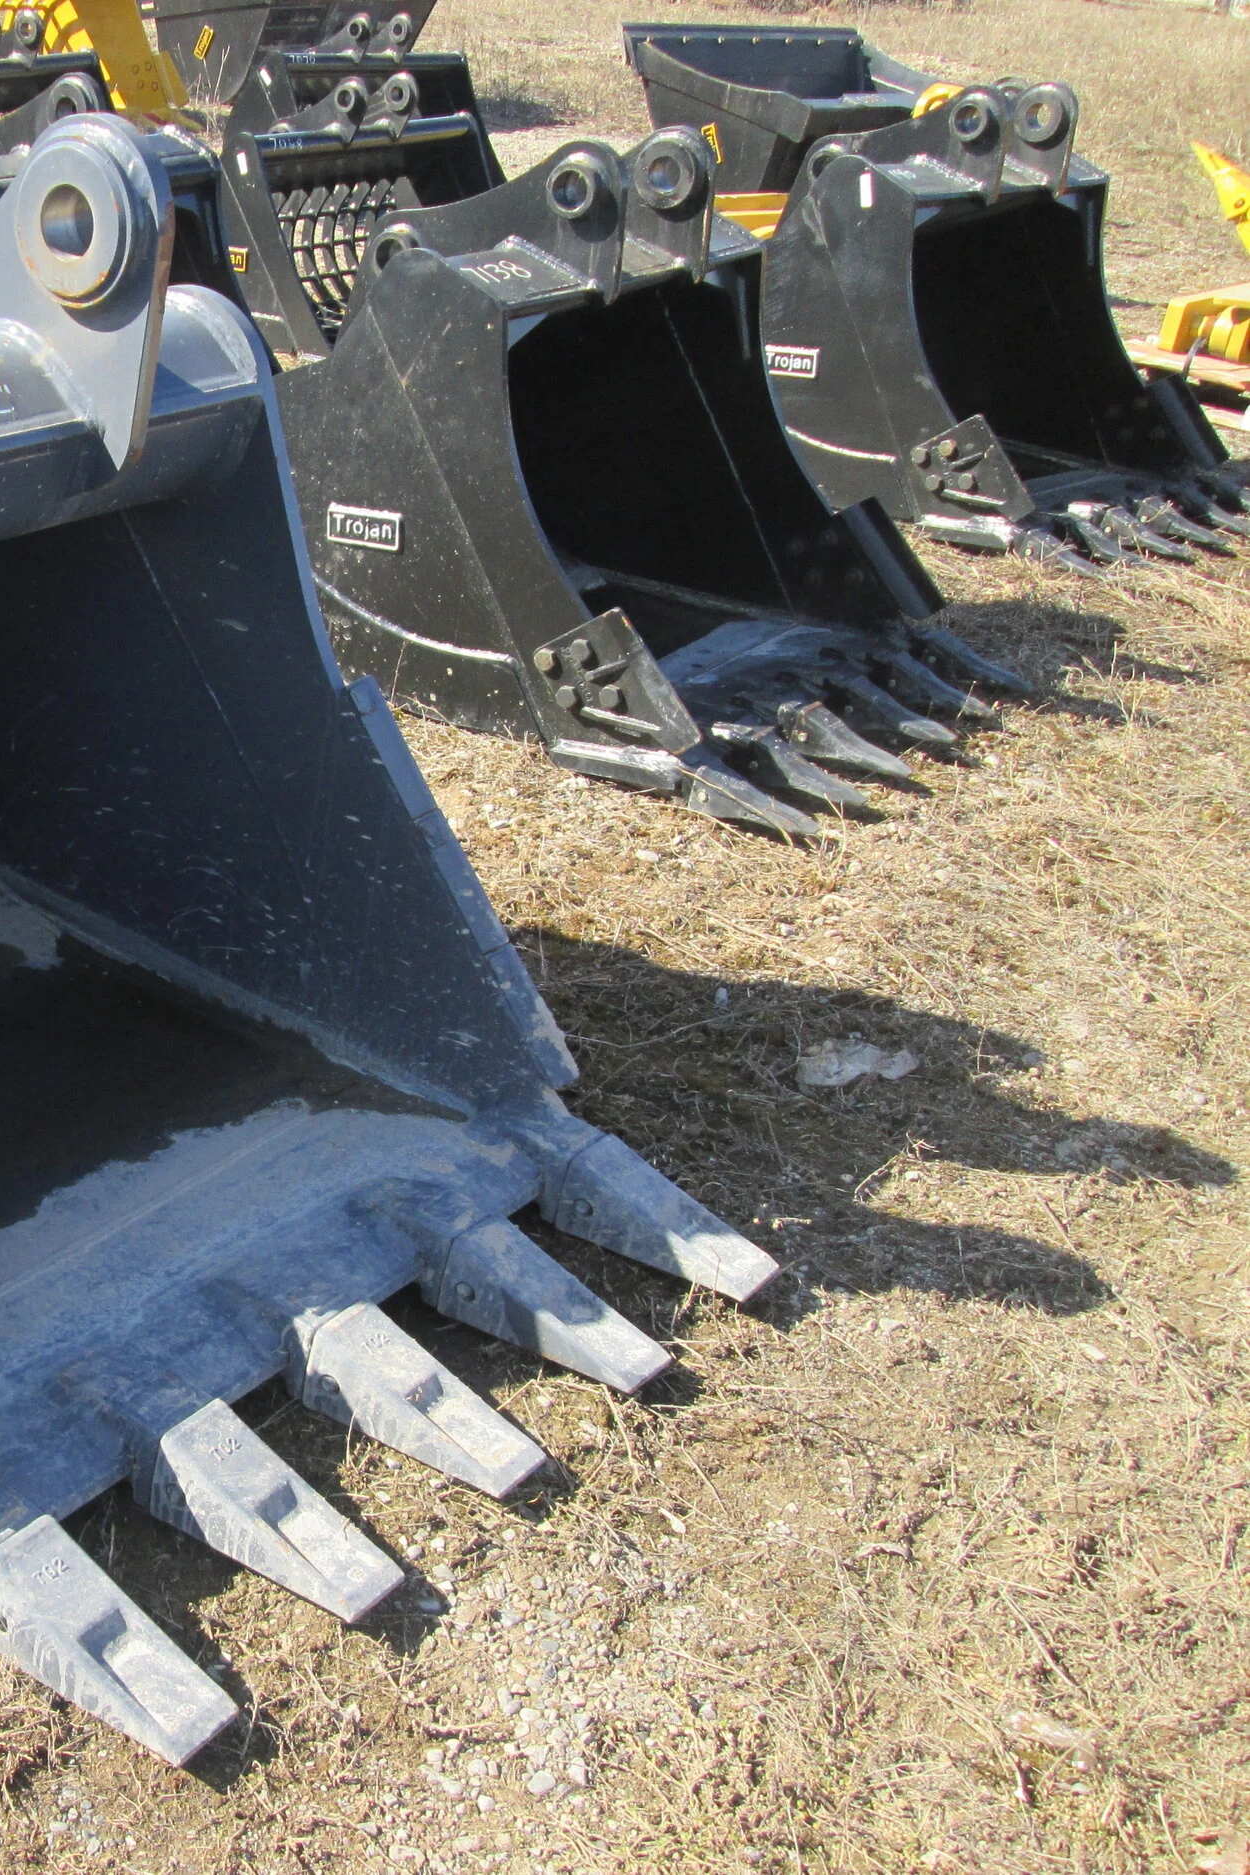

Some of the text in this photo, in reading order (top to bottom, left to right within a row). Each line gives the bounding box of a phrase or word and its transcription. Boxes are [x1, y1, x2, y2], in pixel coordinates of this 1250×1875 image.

[459, 260, 532, 284] 7138
[765, 351, 812, 372] Trojan
[332, 513, 392, 541] Trojan
